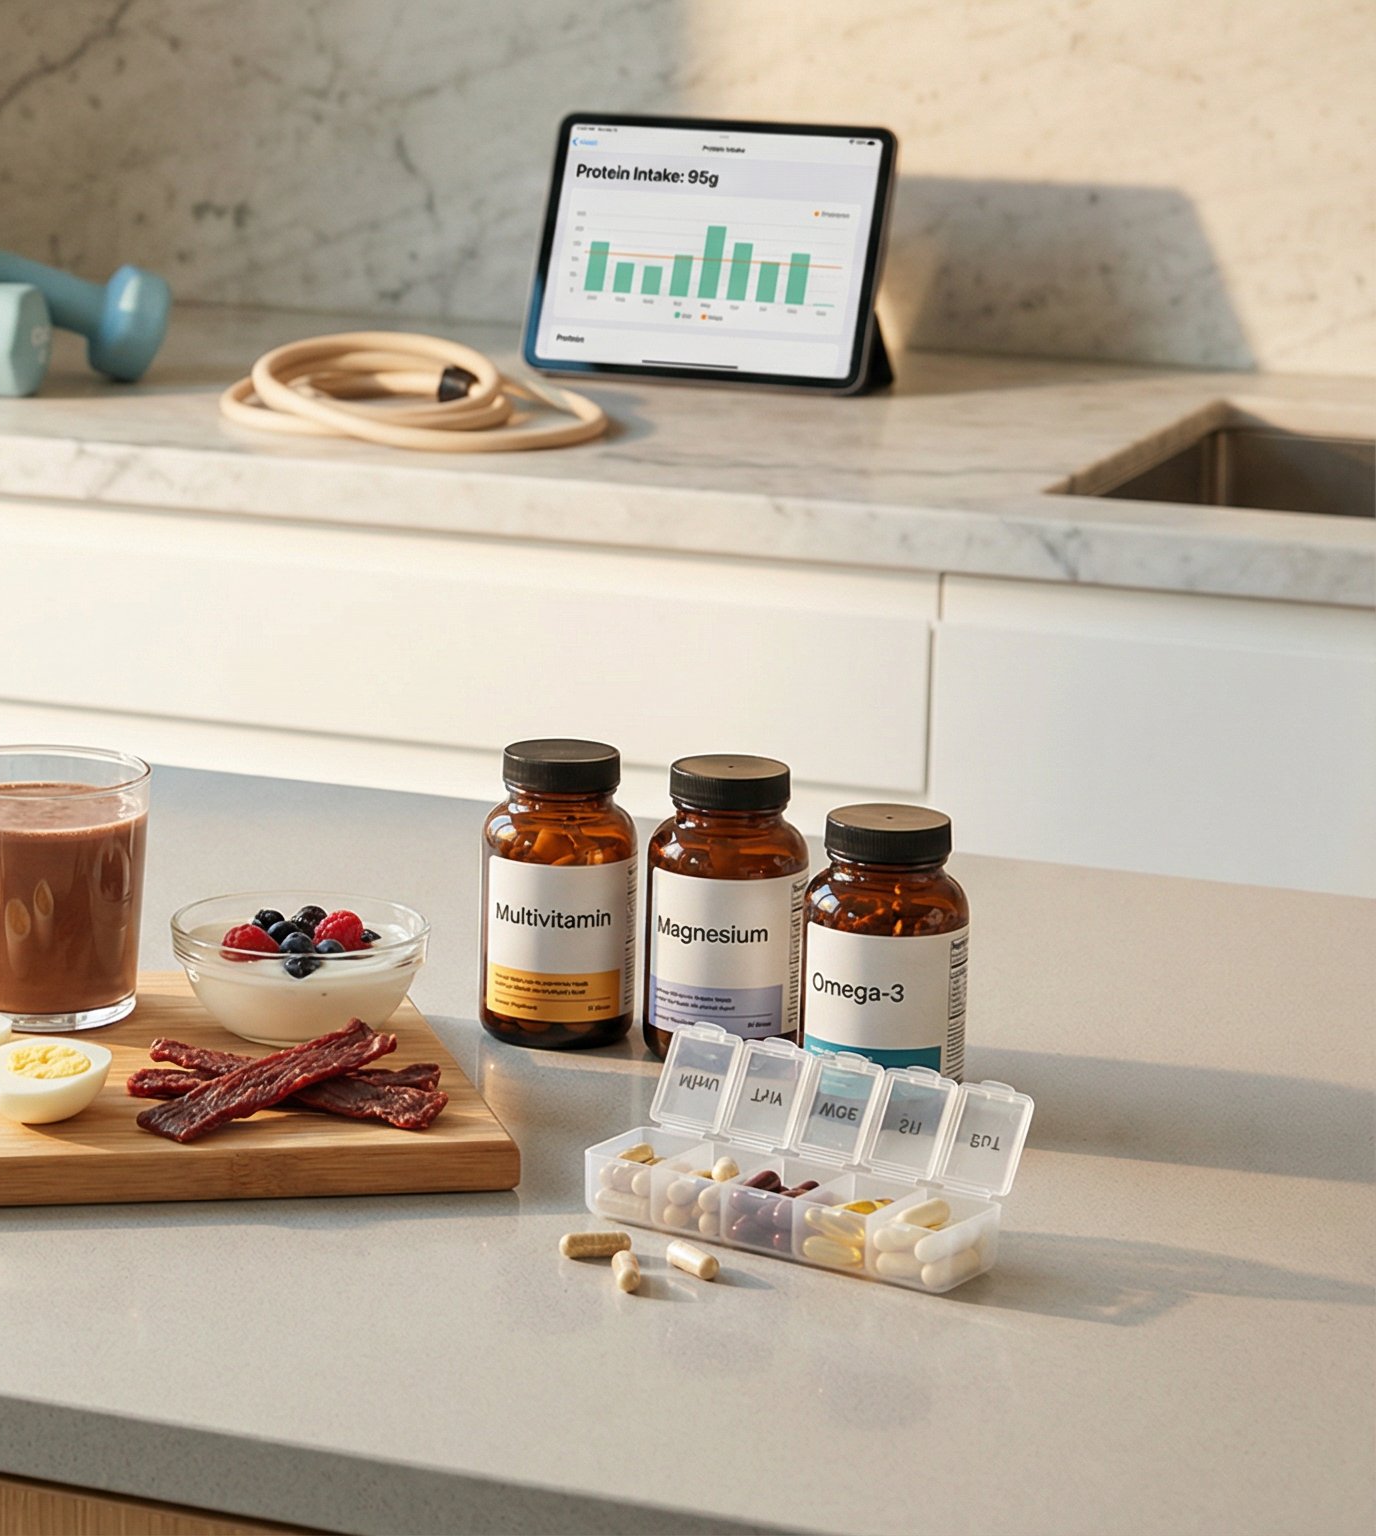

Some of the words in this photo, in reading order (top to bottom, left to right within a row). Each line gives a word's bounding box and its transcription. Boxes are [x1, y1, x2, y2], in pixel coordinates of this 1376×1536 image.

[576, 163, 631, 181] Protein
[633, 166, 685, 184] Intake:
[687, 169, 719, 189] 95g
[496, 902, 612, 930] Multivitamin
[658, 915, 769, 945] Magnesium
[812, 972, 905, 1006] Omega-3
